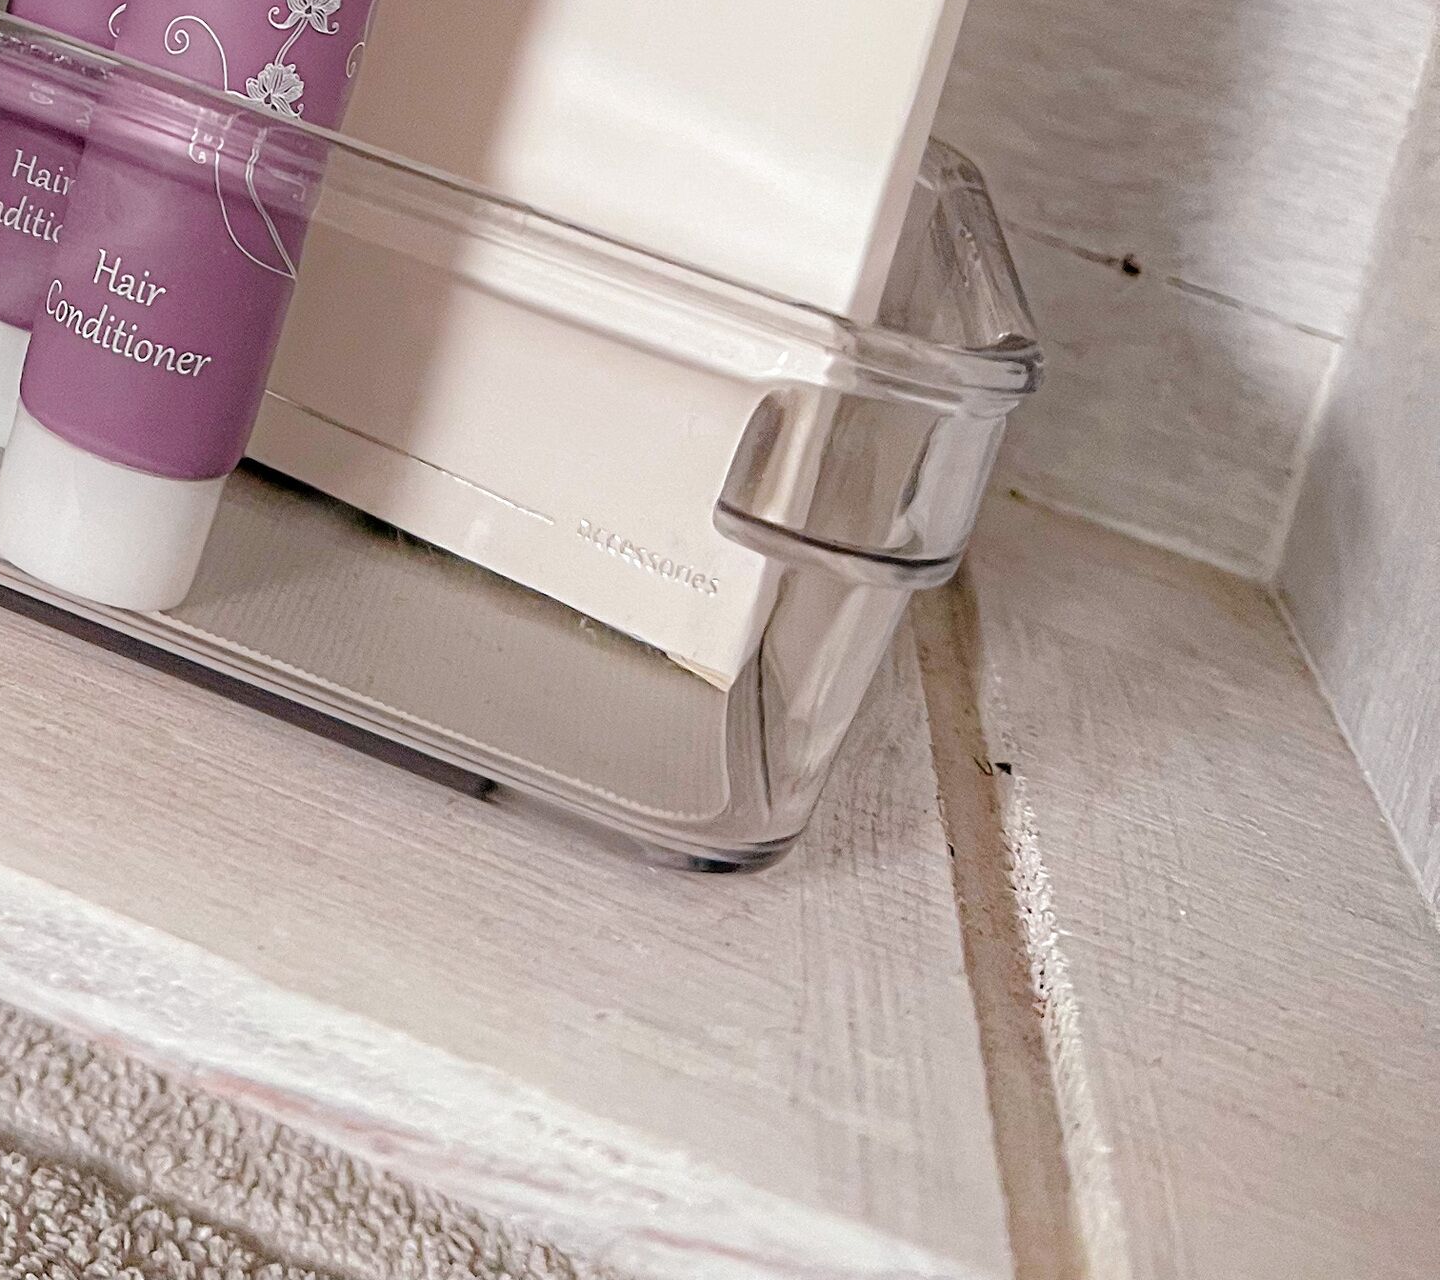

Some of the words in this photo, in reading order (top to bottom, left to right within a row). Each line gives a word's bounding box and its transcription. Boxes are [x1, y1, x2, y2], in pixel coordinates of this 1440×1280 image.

[11, 148, 76, 196] Hair
[93, 248, 167, 307] Hair
[45, 279, 212, 377] Conditioner
[576, 517, 720, 598] accessories
